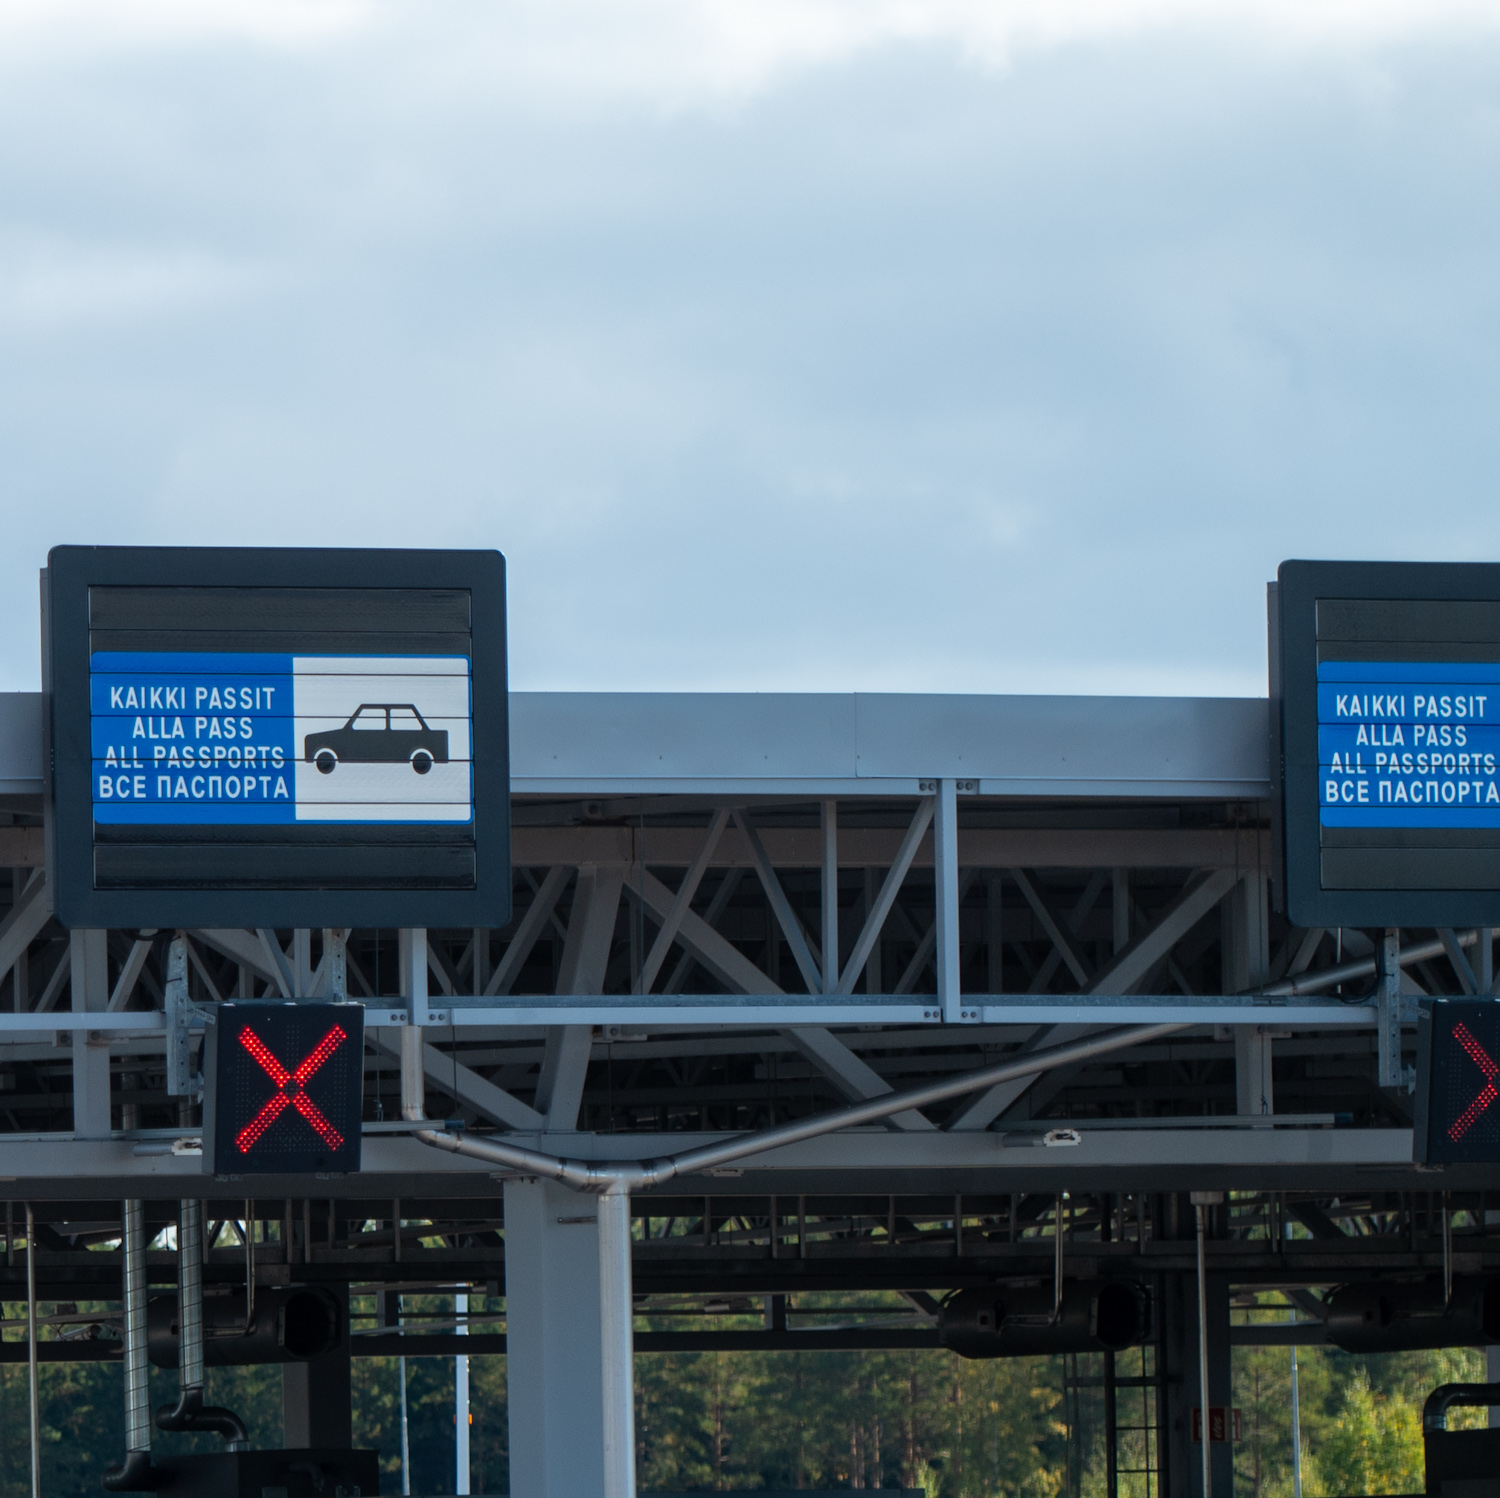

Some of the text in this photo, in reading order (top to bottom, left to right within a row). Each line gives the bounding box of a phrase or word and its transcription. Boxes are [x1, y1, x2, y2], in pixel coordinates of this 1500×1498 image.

[111, 686, 275, 710] KAIKKI PASSIT
[1336, 694, 1487, 718] KAIKKI PASSIT
[132, 716, 253, 739] ALLA PASS
[1356, 724, 1467, 746] ALLA PASS
[105, 746, 285, 769] ALL PASSPORTS
[1330, 752, 1496, 775] ALL PASSPORTS
[99, 775, 289, 798] ВСЕ ПАСПОРТА
[1325, 780, 1500, 803] ВСЕ ПАСПОРТА
